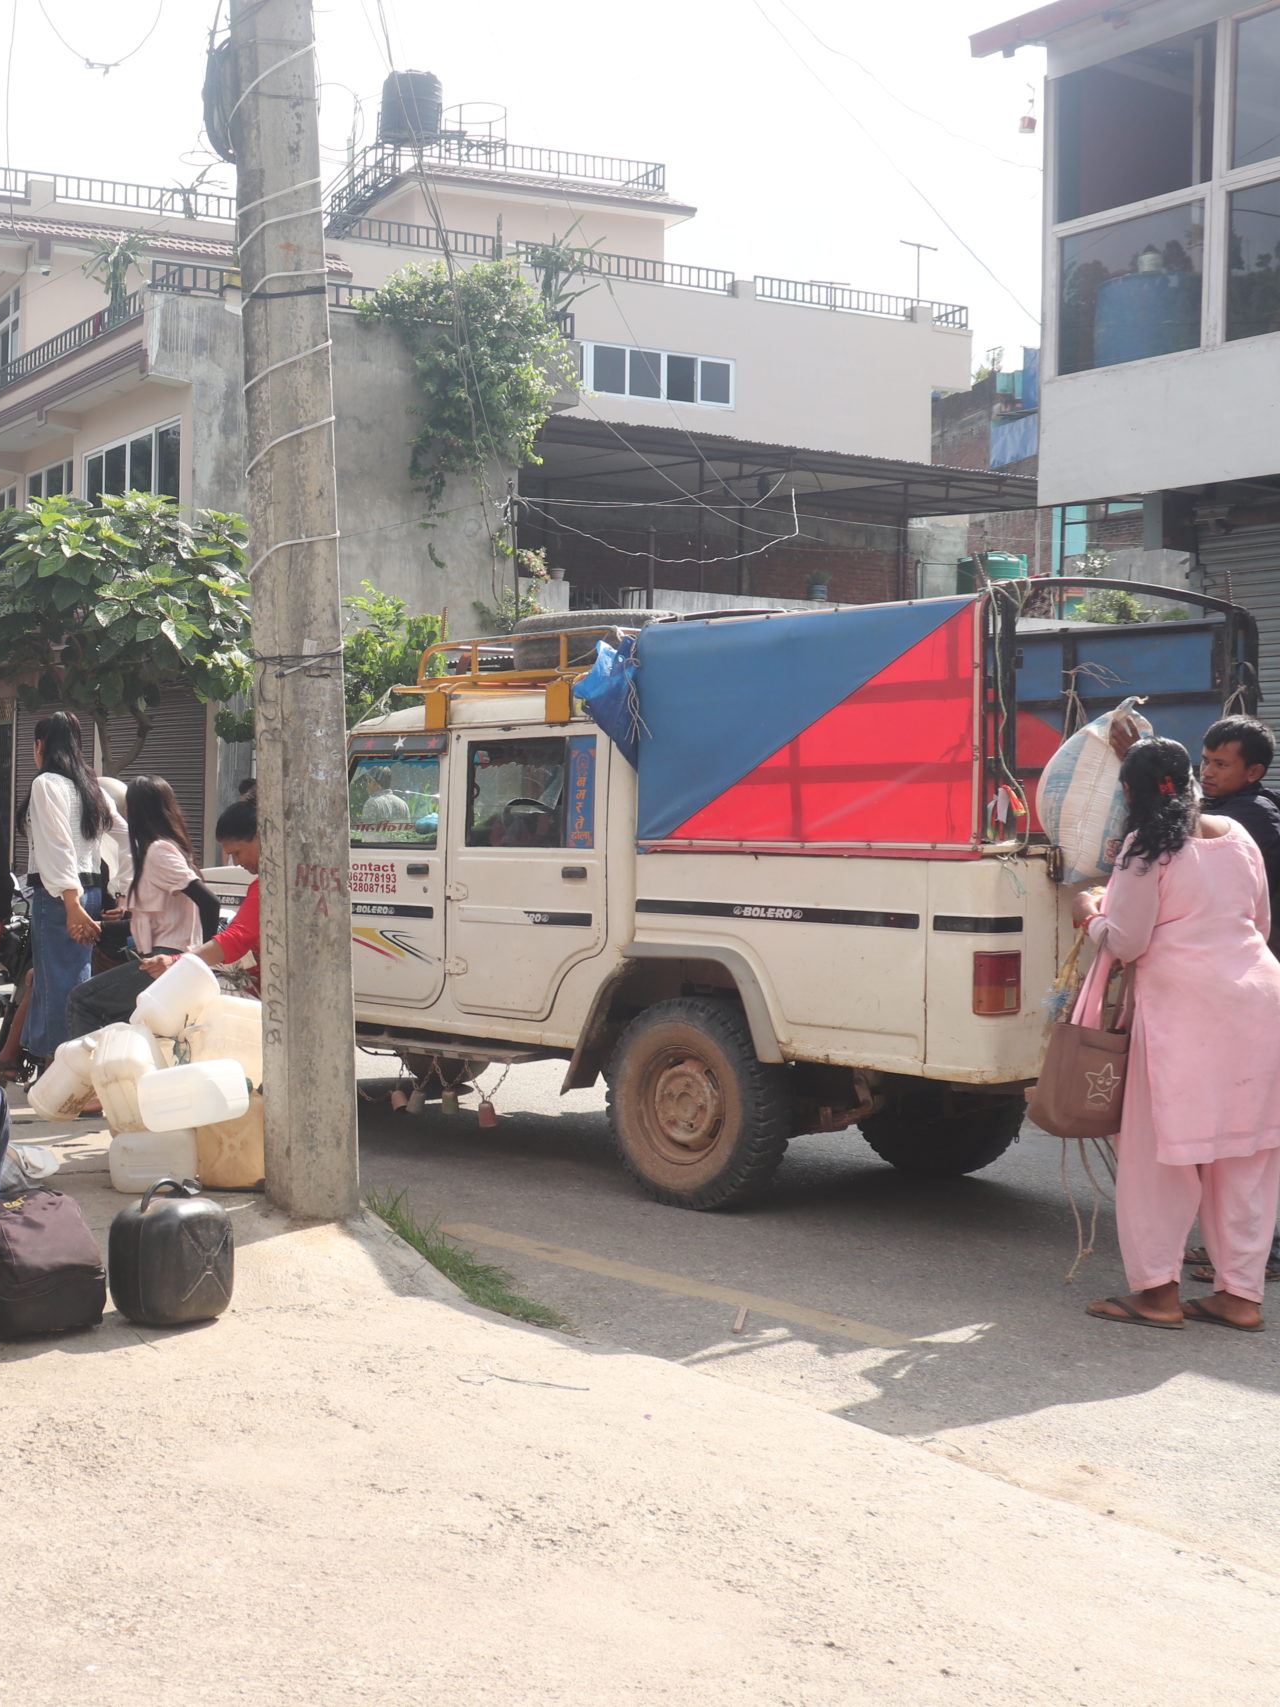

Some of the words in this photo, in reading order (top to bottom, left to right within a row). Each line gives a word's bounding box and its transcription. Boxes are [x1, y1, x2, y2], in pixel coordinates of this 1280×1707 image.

[351, 862, 395, 872] ontact
[356, 905, 388, 914] BOLERO
[742, 906, 793, 919] BOLERO
